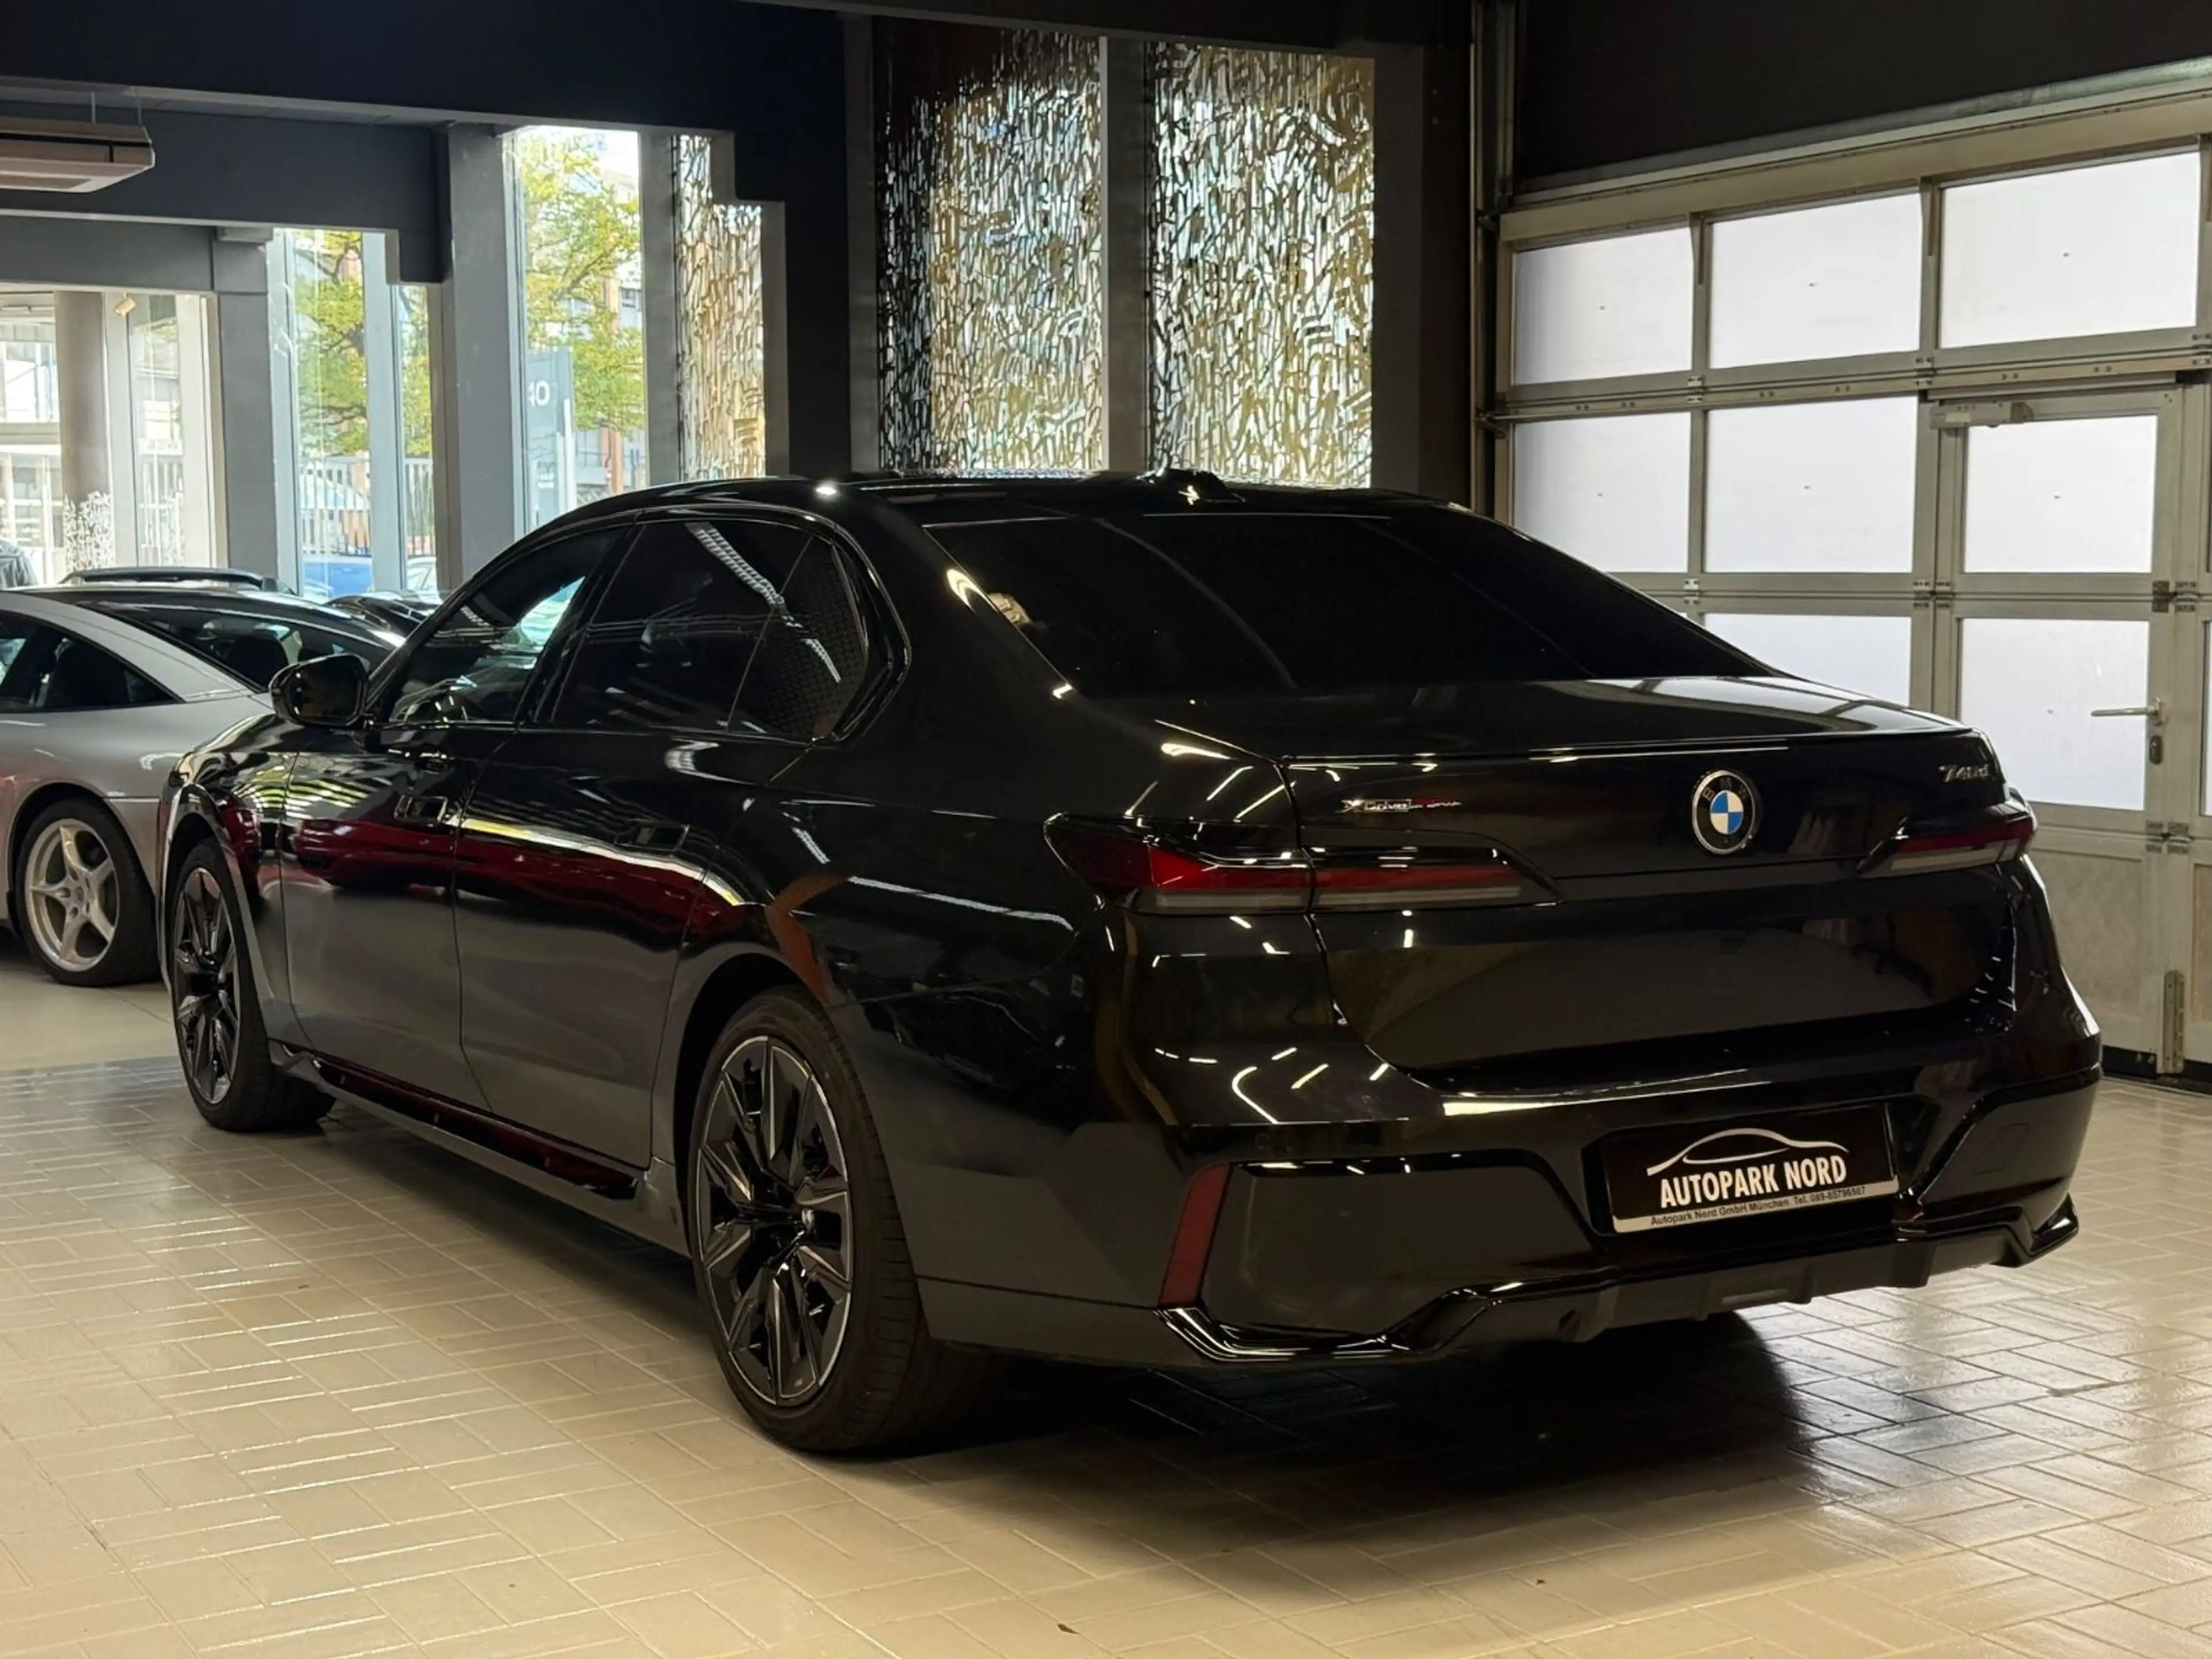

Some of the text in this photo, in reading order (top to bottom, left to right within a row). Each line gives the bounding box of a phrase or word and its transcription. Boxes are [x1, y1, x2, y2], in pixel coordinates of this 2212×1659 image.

[1702, 777, 1749, 802] BMW
[1660, 1155, 1847, 1208] AUTOPARK NORD
[1651, 1211, 1692, 1225] Autopark
[1695, 1209, 1718, 1218] Nord
[1719, 1204, 1748, 1216] GmbH
[1749, 1199, 1789, 1210] München
